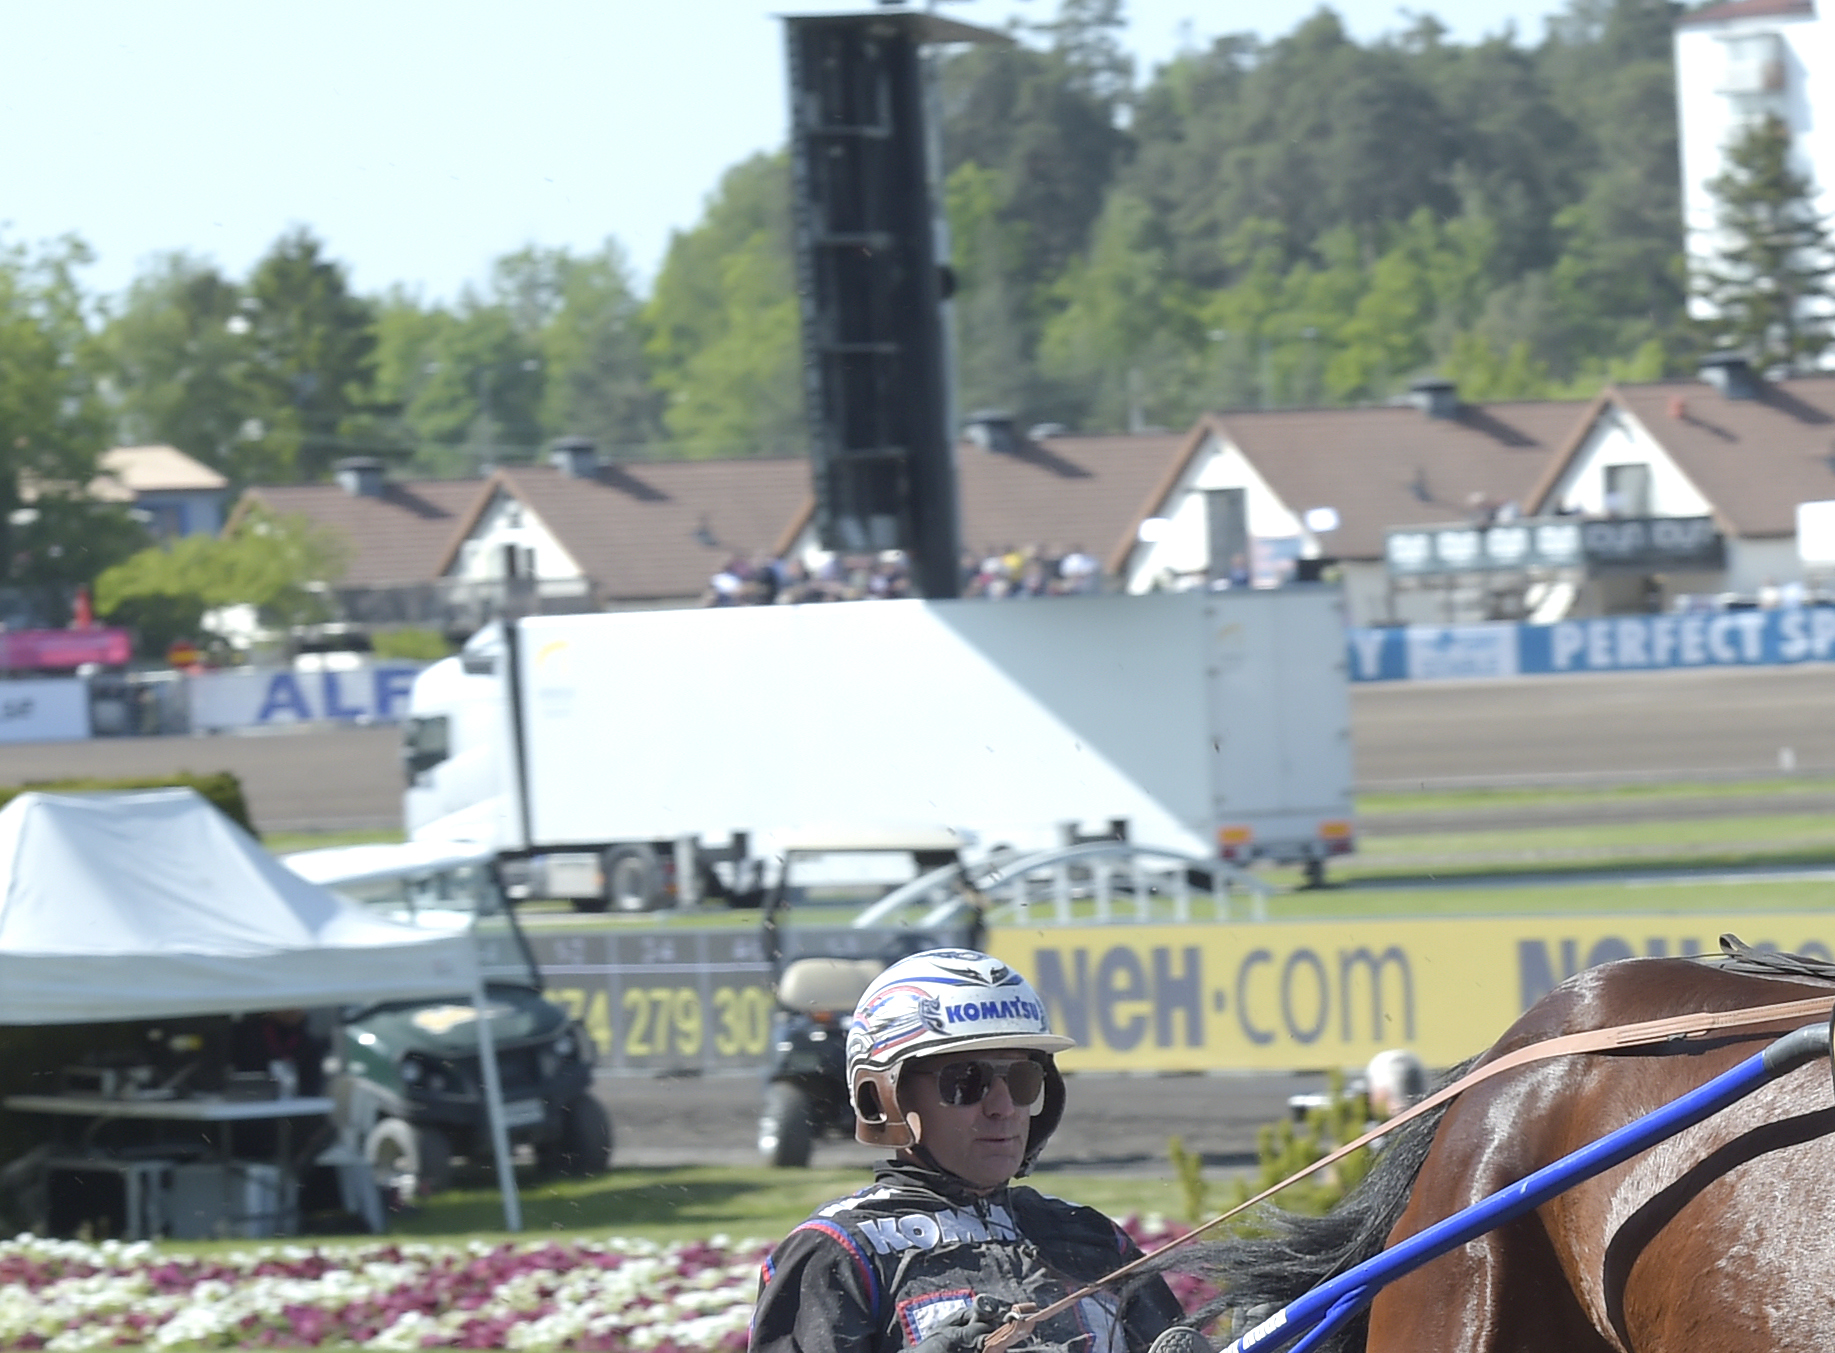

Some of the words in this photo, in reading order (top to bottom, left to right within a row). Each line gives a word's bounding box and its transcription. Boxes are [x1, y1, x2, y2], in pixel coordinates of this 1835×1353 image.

[1552, 613, 1766, 668] PERFECT
[623, 987, 700, 1055] 279
[945, 996, 1039, 1024] KOMATSU
